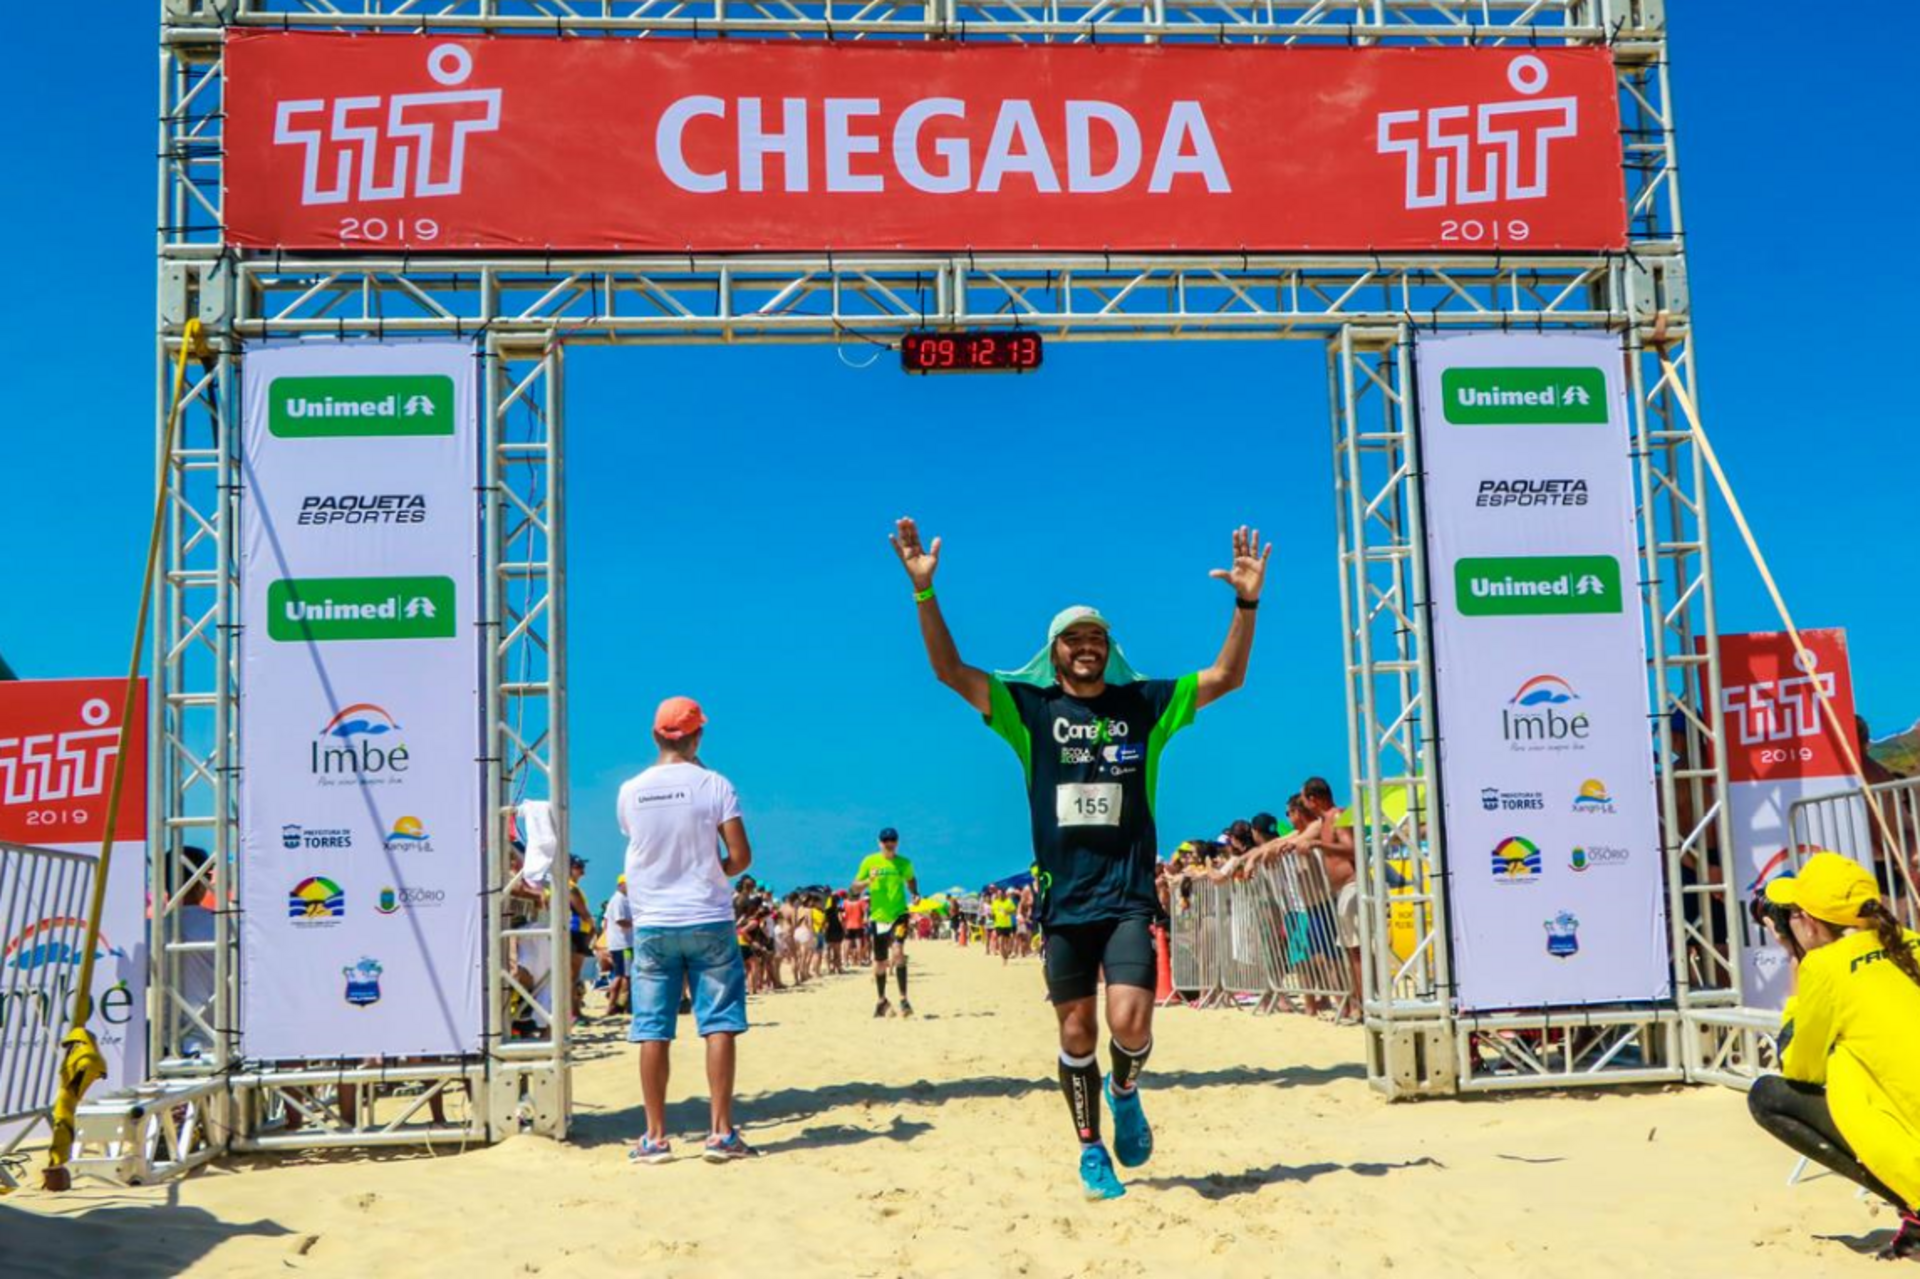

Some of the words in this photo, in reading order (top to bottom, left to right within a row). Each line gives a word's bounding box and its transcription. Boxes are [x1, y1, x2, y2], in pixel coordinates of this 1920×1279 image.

[655, 94, 1231, 193] CHEGADA
[339, 217, 439, 240] 2019
[1441, 219, 1530, 241] 2019
[1457, 386, 1555, 406] Unimed
[286, 396, 395, 417] Unimed
[1479, 479, 1588, 494] PAQUETA
[302, 494, 426, 511] PAQUETA
[1476, 493, 1588, 507] ESPORTES
[297, 510, 426, 525] ESPORTES
[1470, 576, 1568, 597] Unimed
[285, 597, 395, 620] Unimed
[1052, 716, 1129, 744] Conexão
[1503, 708, 1590, 740] Imbé
[312, 739, 409, 773] Imbé
[1760, 747, 1814, 763] 2019
[1074, 797, 1109, 815] 155
[1502, 798, 1545, 811] TORRES
[26, 809, 89, 826] 2019
[304, 836, 352, 849] TORRES
